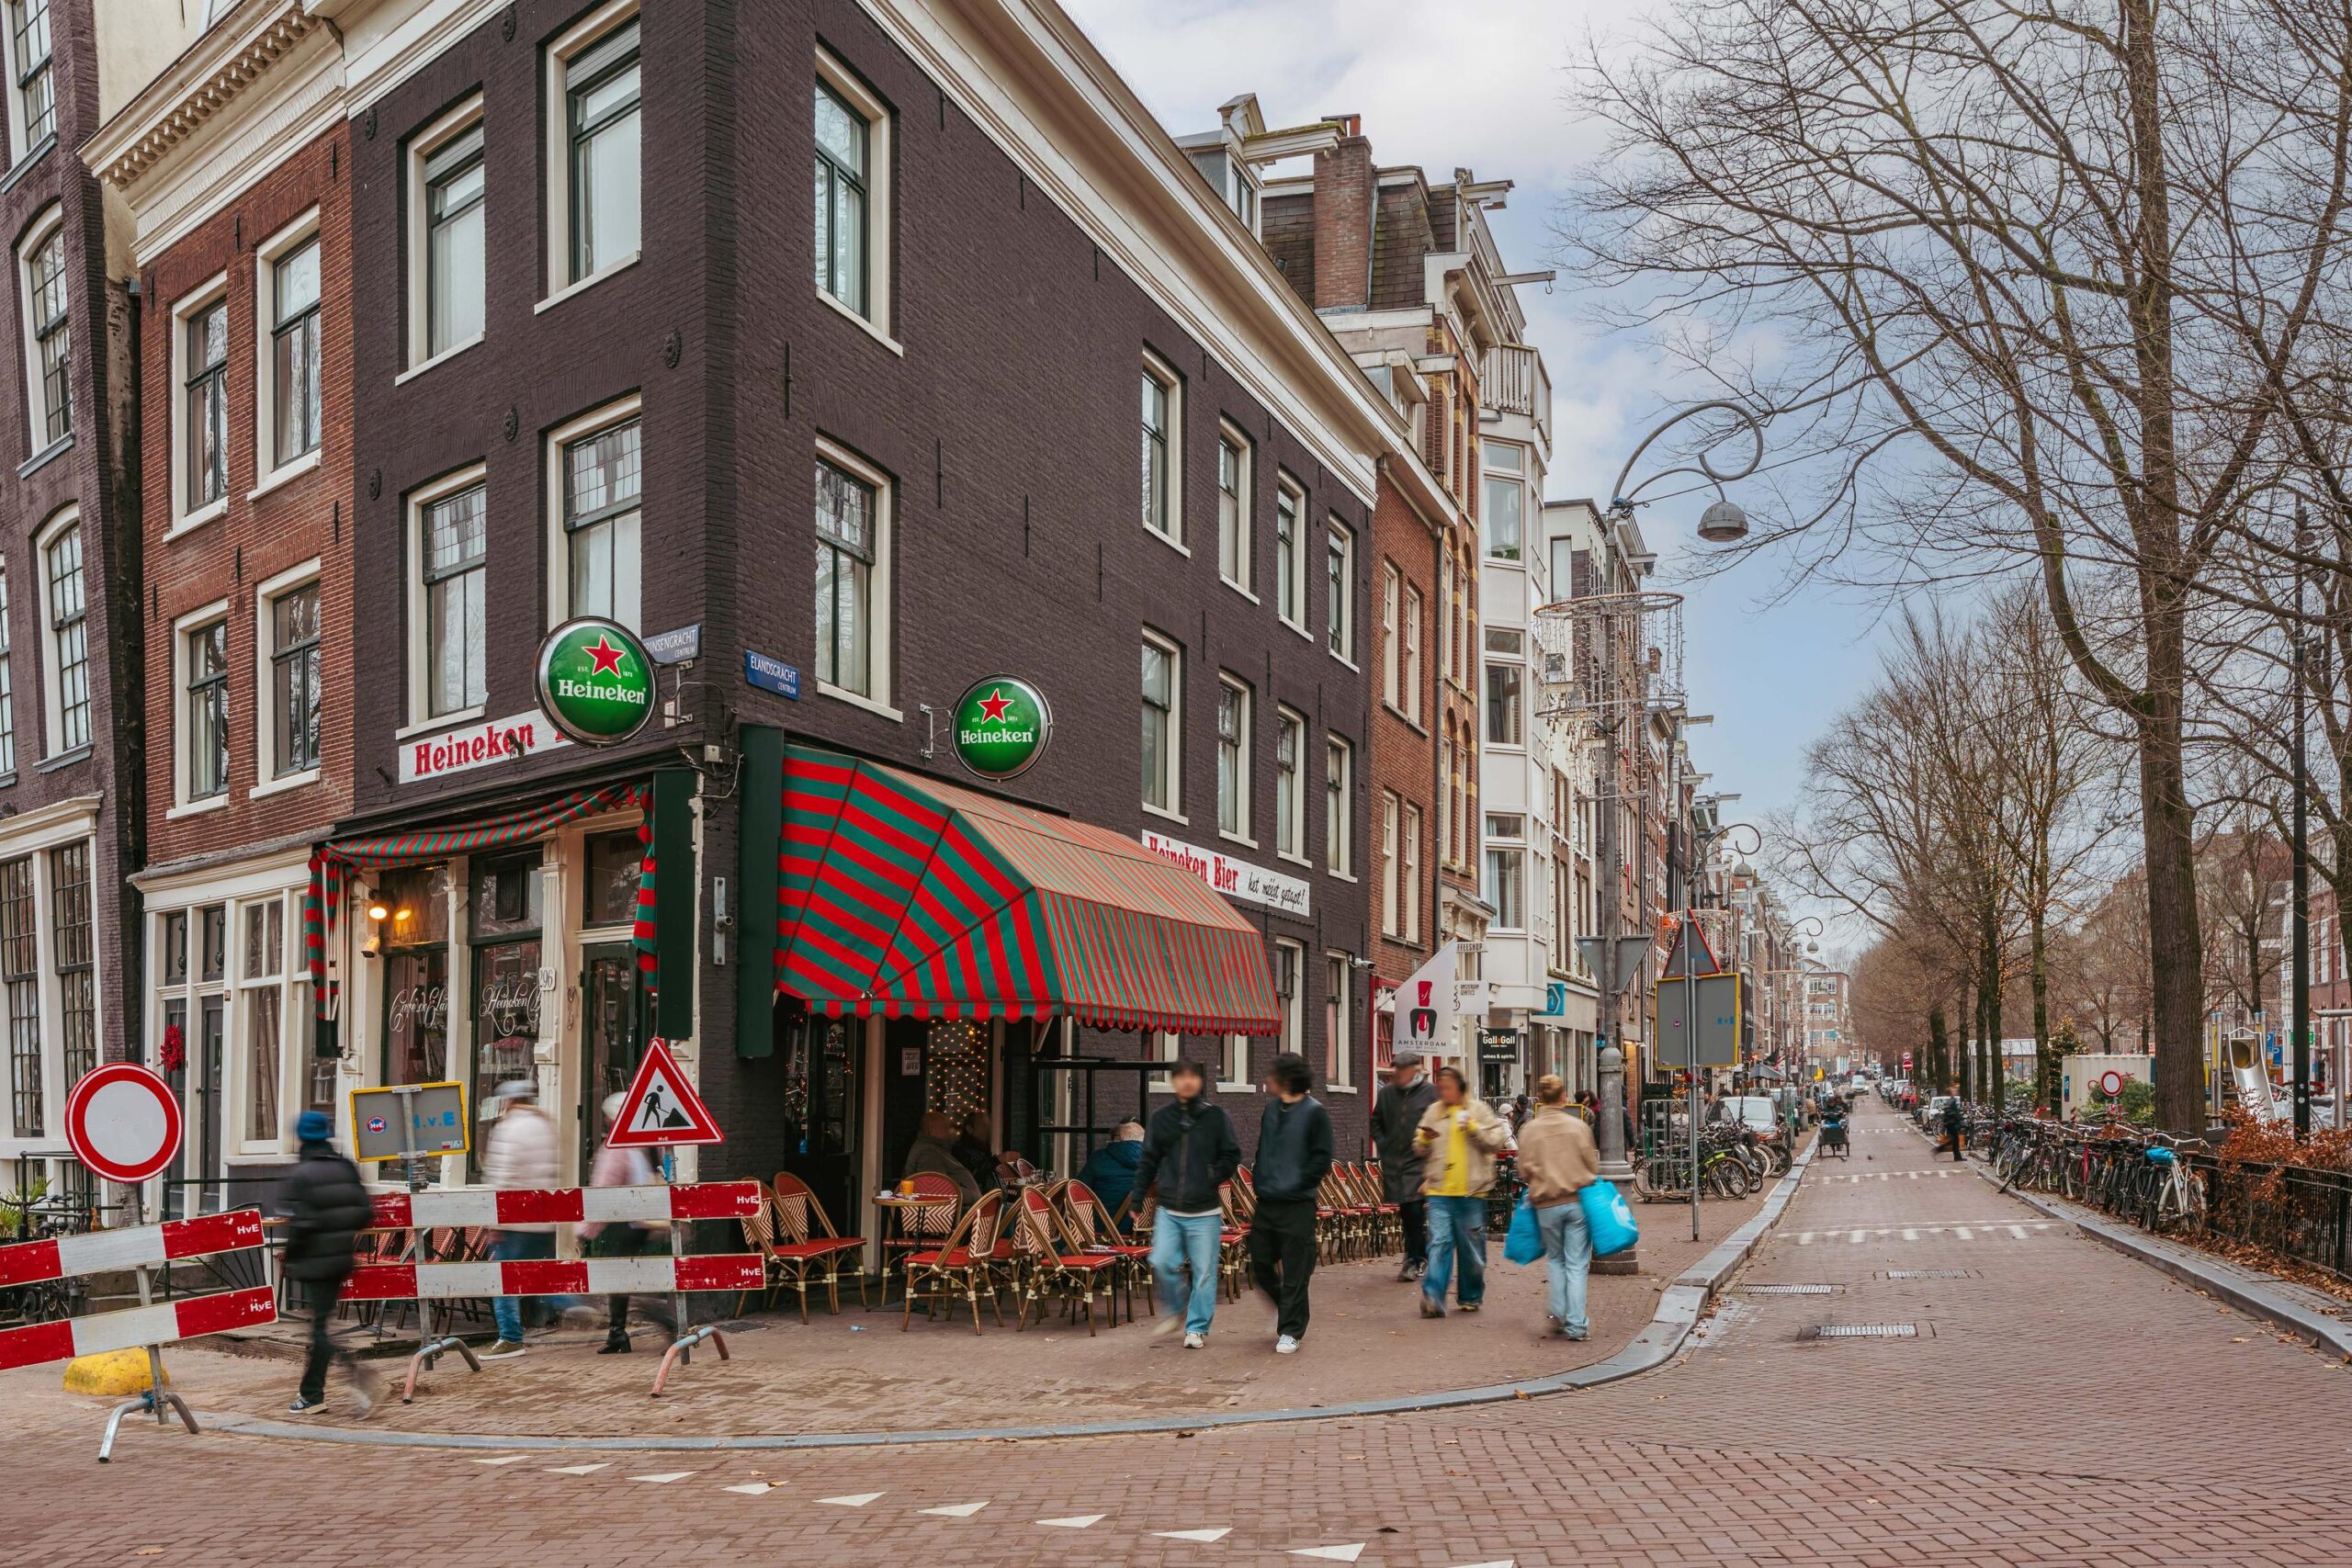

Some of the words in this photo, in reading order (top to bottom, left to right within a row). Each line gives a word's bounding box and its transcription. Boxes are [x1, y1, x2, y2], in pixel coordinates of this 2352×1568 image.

[674, 646, 695, 659] CENTRUM
[750, 655, 797, 684] ELANDSGRACHT
[558, 680, 646, 705] Heineken
[777, 682, 797, 695] CENTRUM
[961, 728, 1034, 745] Heineken
[414, 723, 536, 776] Heineken
[1214, 856, 1238, 892] Bier
[1248, 872, 1260, 894] het
[1280, 887, 1306, 910] getapt!
[539, 969, 553, 988] 296
[1482, 1035, 1497, 1044] Gall
[1501, 1035, 1515, 1044] Gall
[736, 1196, 758, 1204] HvE
[237, 1224, 260, 1235] HvE
[741, 1268, 762, 1276] HvE
[250, 1301, 272, 1313] HvE
